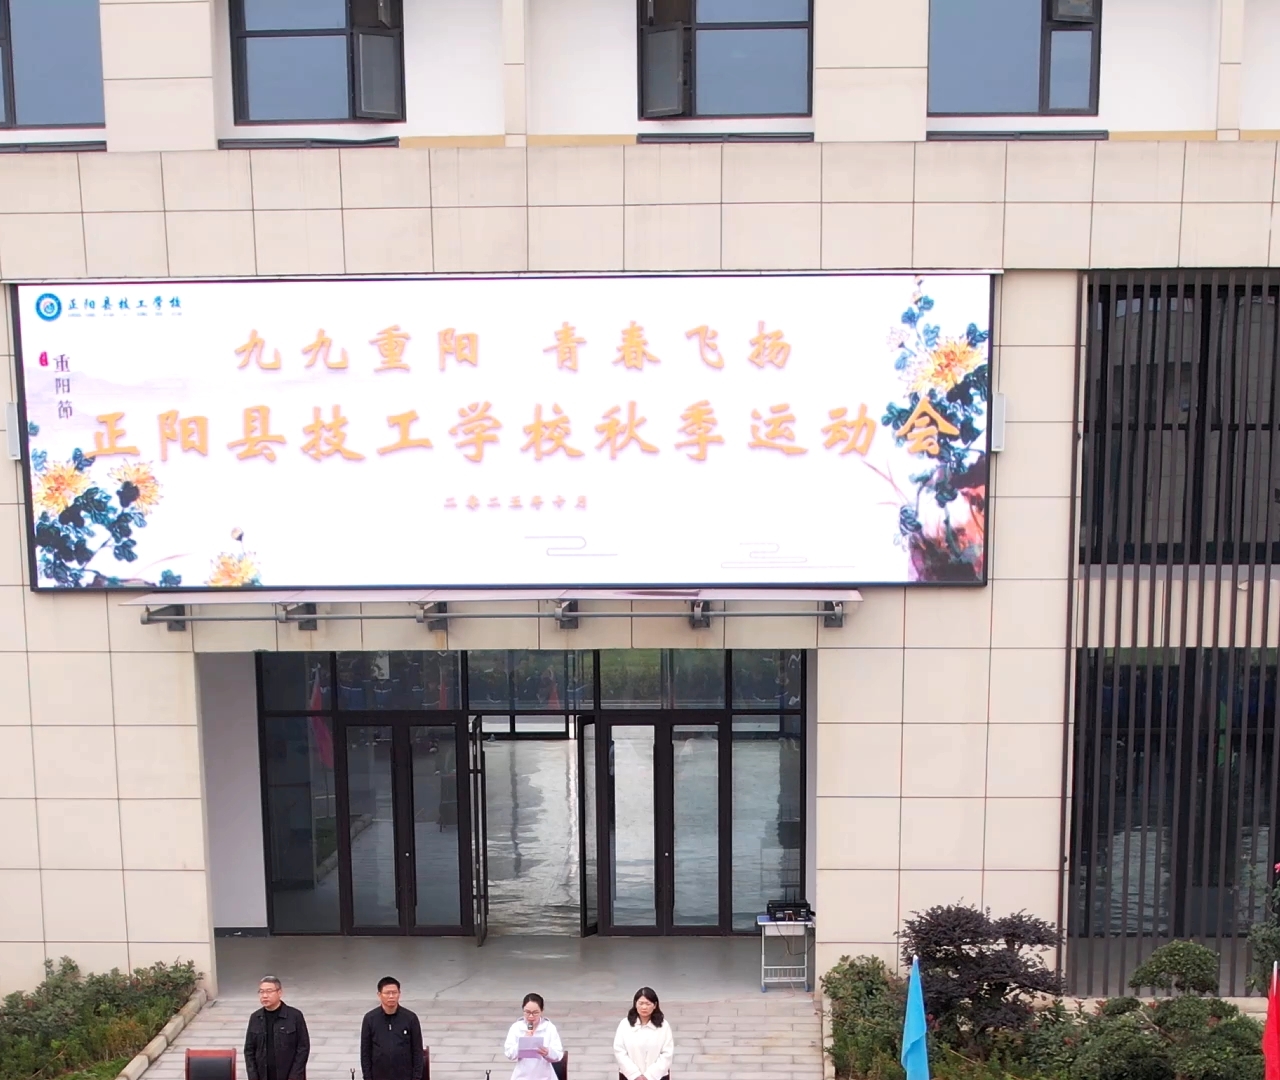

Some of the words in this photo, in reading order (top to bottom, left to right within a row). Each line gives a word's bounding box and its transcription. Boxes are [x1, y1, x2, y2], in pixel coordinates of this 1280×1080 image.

[234, 325, 479, 372] 九九重阳
[543, 321, 791, 372] 青春飞扬
[85, 401, 960, 463] 正阳县技工学校秋季运动会
